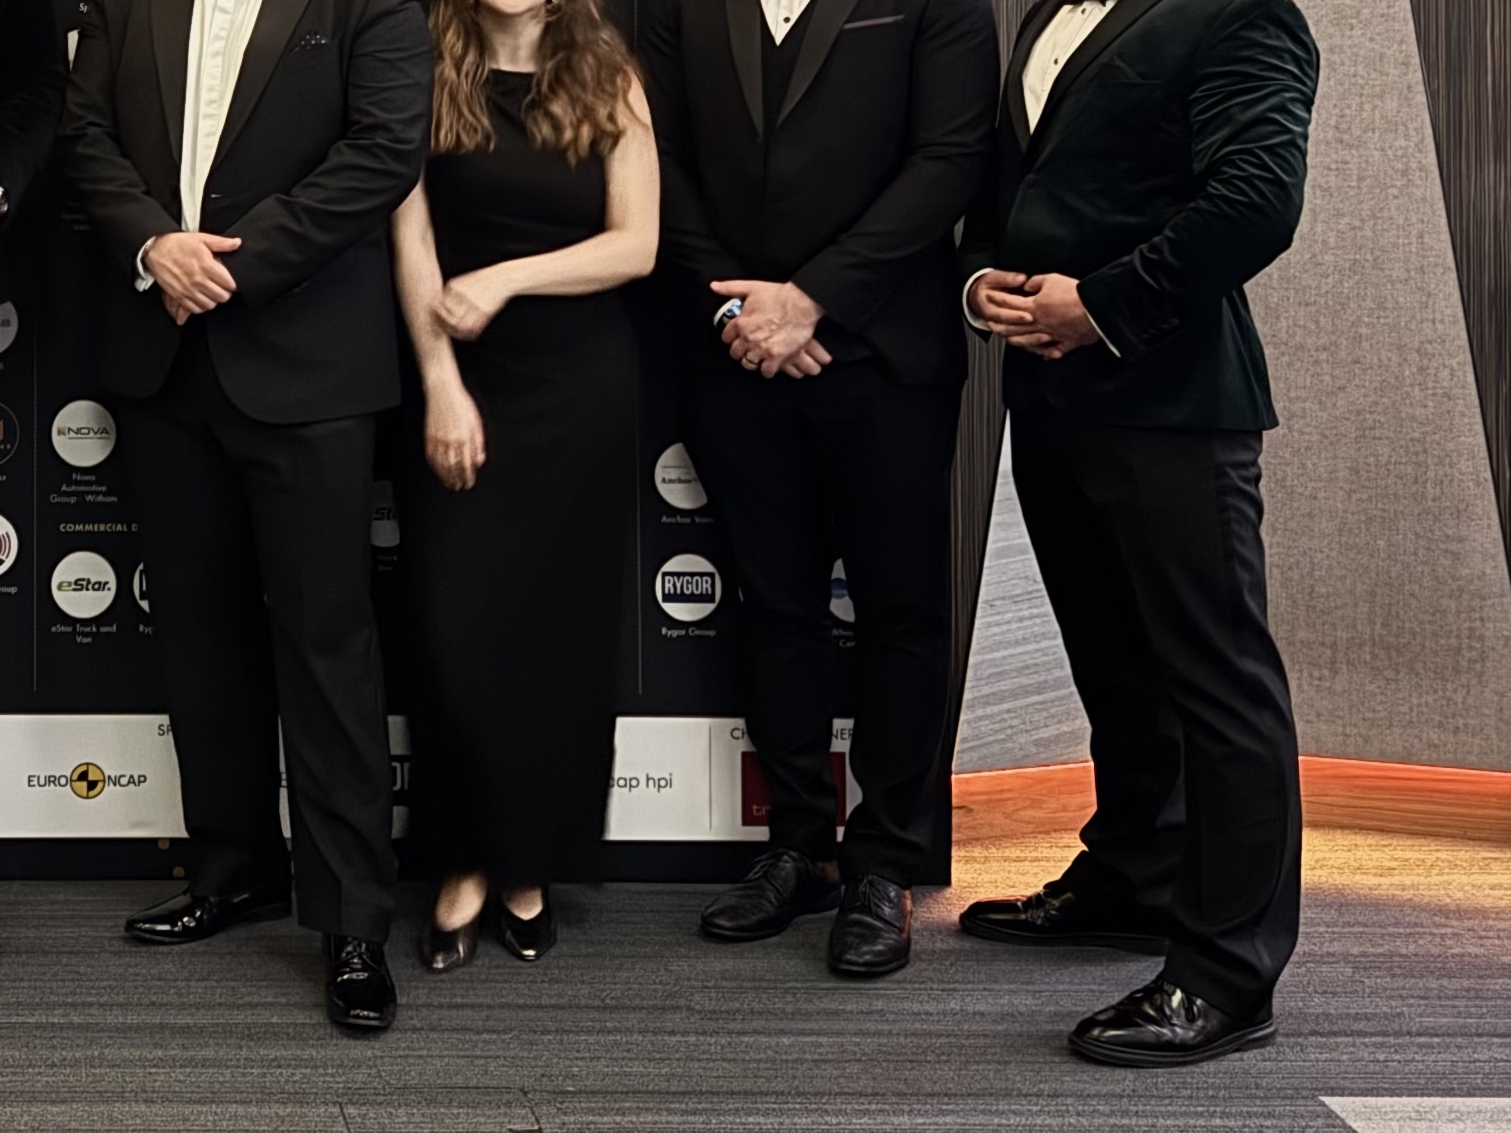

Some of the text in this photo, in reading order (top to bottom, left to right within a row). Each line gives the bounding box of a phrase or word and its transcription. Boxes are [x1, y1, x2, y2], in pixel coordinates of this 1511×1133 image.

[59, 523, 127, 532] COMMERCIAL
[664, 576, 712, 594] RYGOR
[99, 624, 117, 633] and
[28, 774, 147, 787] EURO NCAP
[646, 773, 672, 792] hpi
